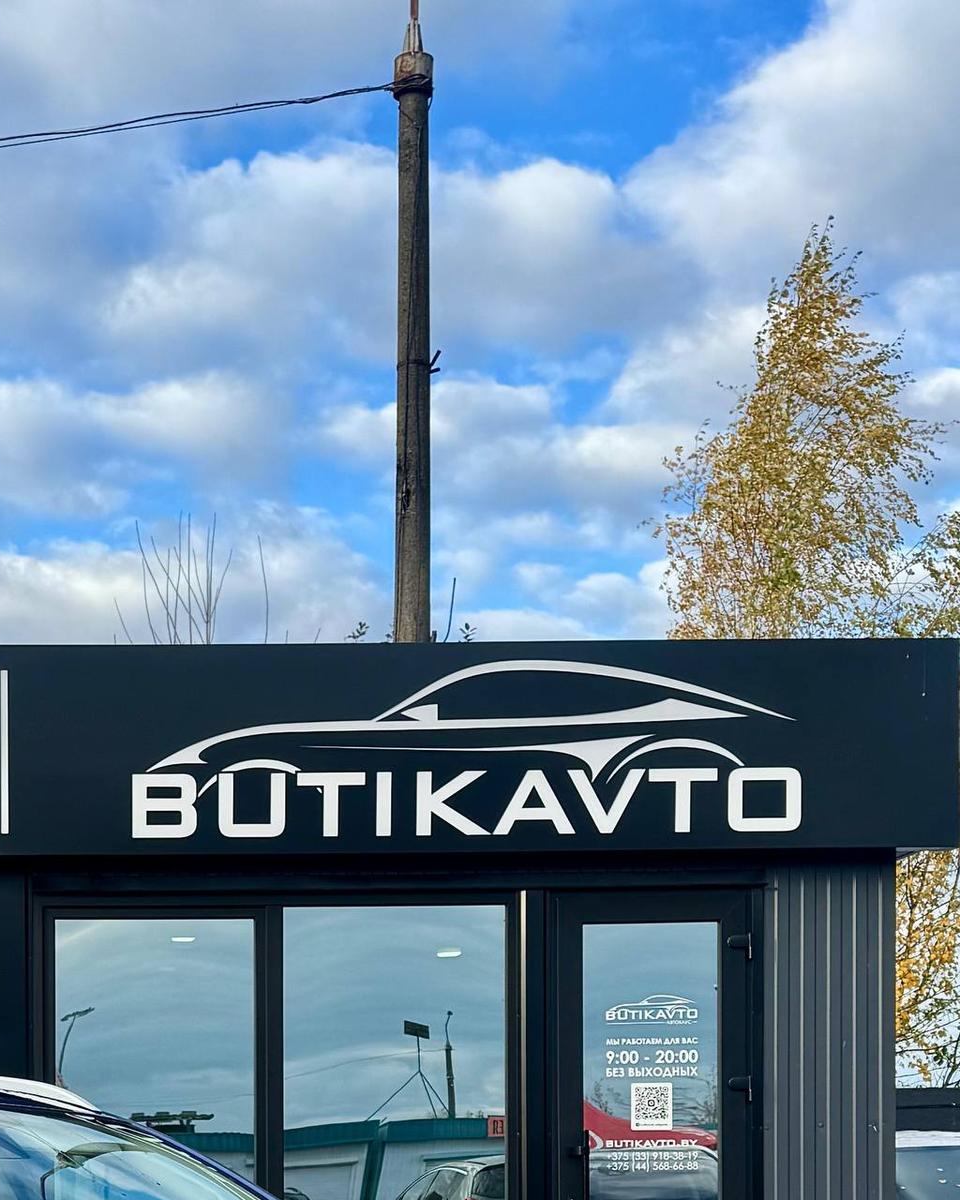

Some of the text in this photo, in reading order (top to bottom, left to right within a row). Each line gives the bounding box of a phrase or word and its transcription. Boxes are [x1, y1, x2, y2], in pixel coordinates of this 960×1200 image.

[131, 765, 803, 840] BUTIKAVTO
[605, 1009, 699, 1021] BUTIKAVTO
[606, 1037, 699, 1046] МЫ РАБОТАЕМ ДЛЯ ВАС
[606, 1050, 640, 1065] 9:00
[655, 1049, 699, 1064] 20:00
[605, 1066, 699, 1078] БЕЗ ВЫХОДНЫХ
[605, 1139, 699, 1148] BUTIKAVTO.BY
[606, 1151, 630, 1161] +375
[652, 1151, 699, 1161] 918-38-19
[606, 1160, 699, 1173] +375 (44) 568-66-88
